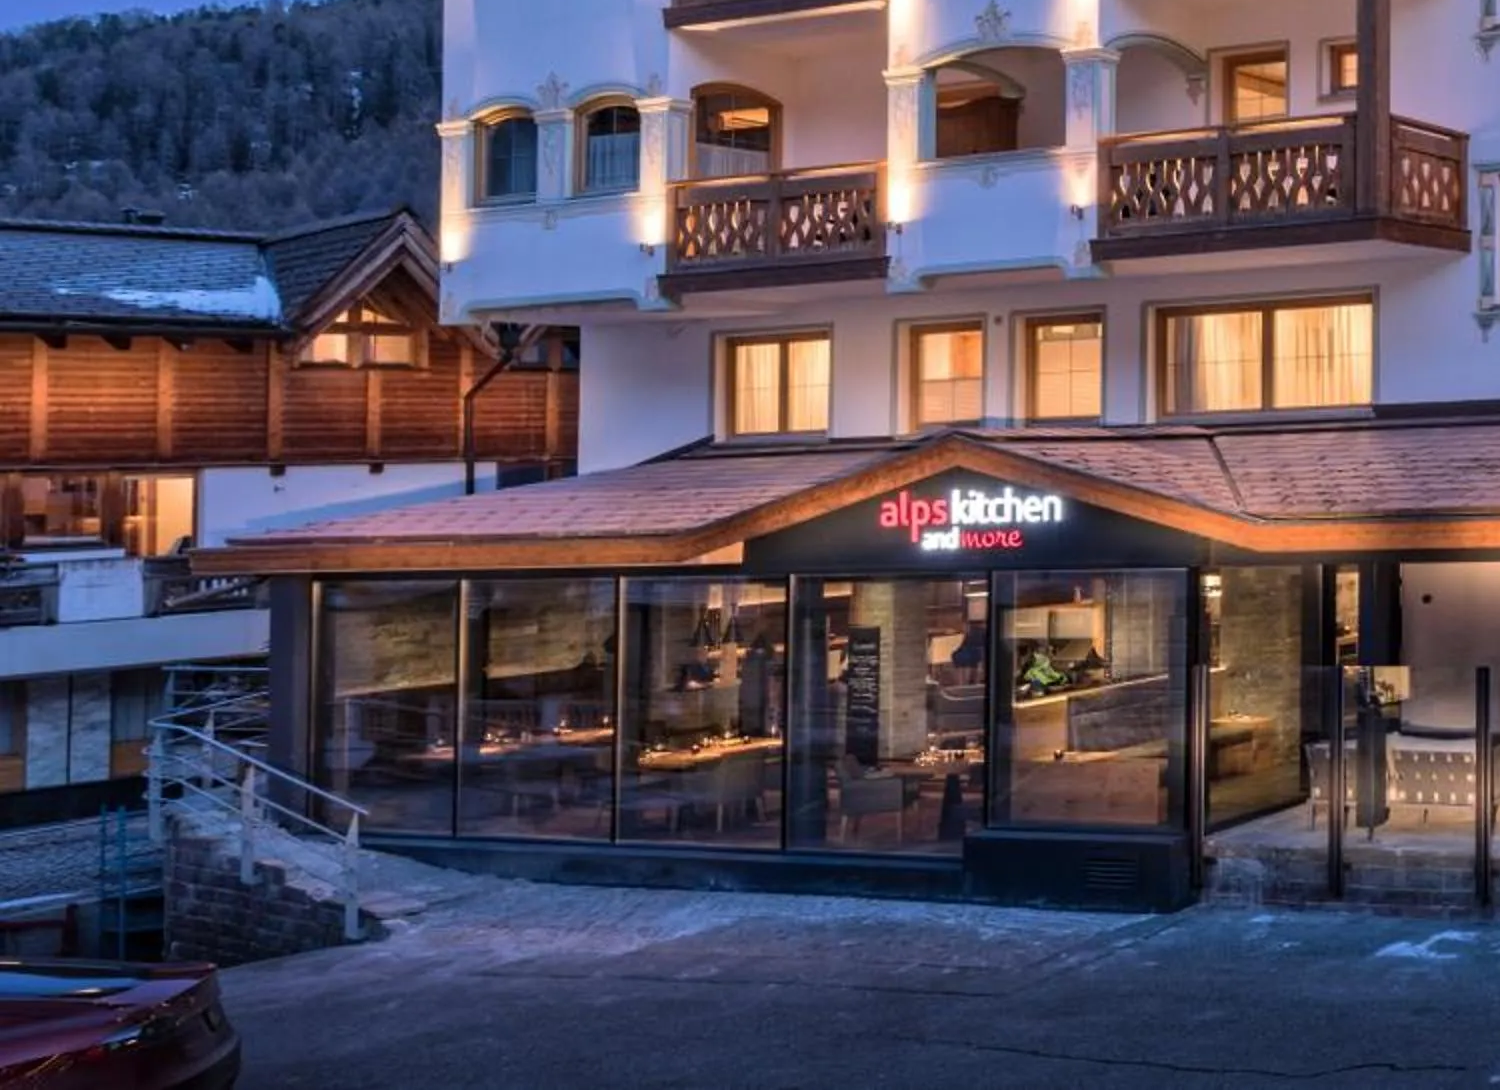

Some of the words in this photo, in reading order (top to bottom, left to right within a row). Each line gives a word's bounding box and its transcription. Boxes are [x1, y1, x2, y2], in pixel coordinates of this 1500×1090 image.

[879, 490, 949, 543] alps
[951, 486, 1064, 525] kitchen
[921, 526, 960, 551] and
[961, 528, 1024, 550] more
